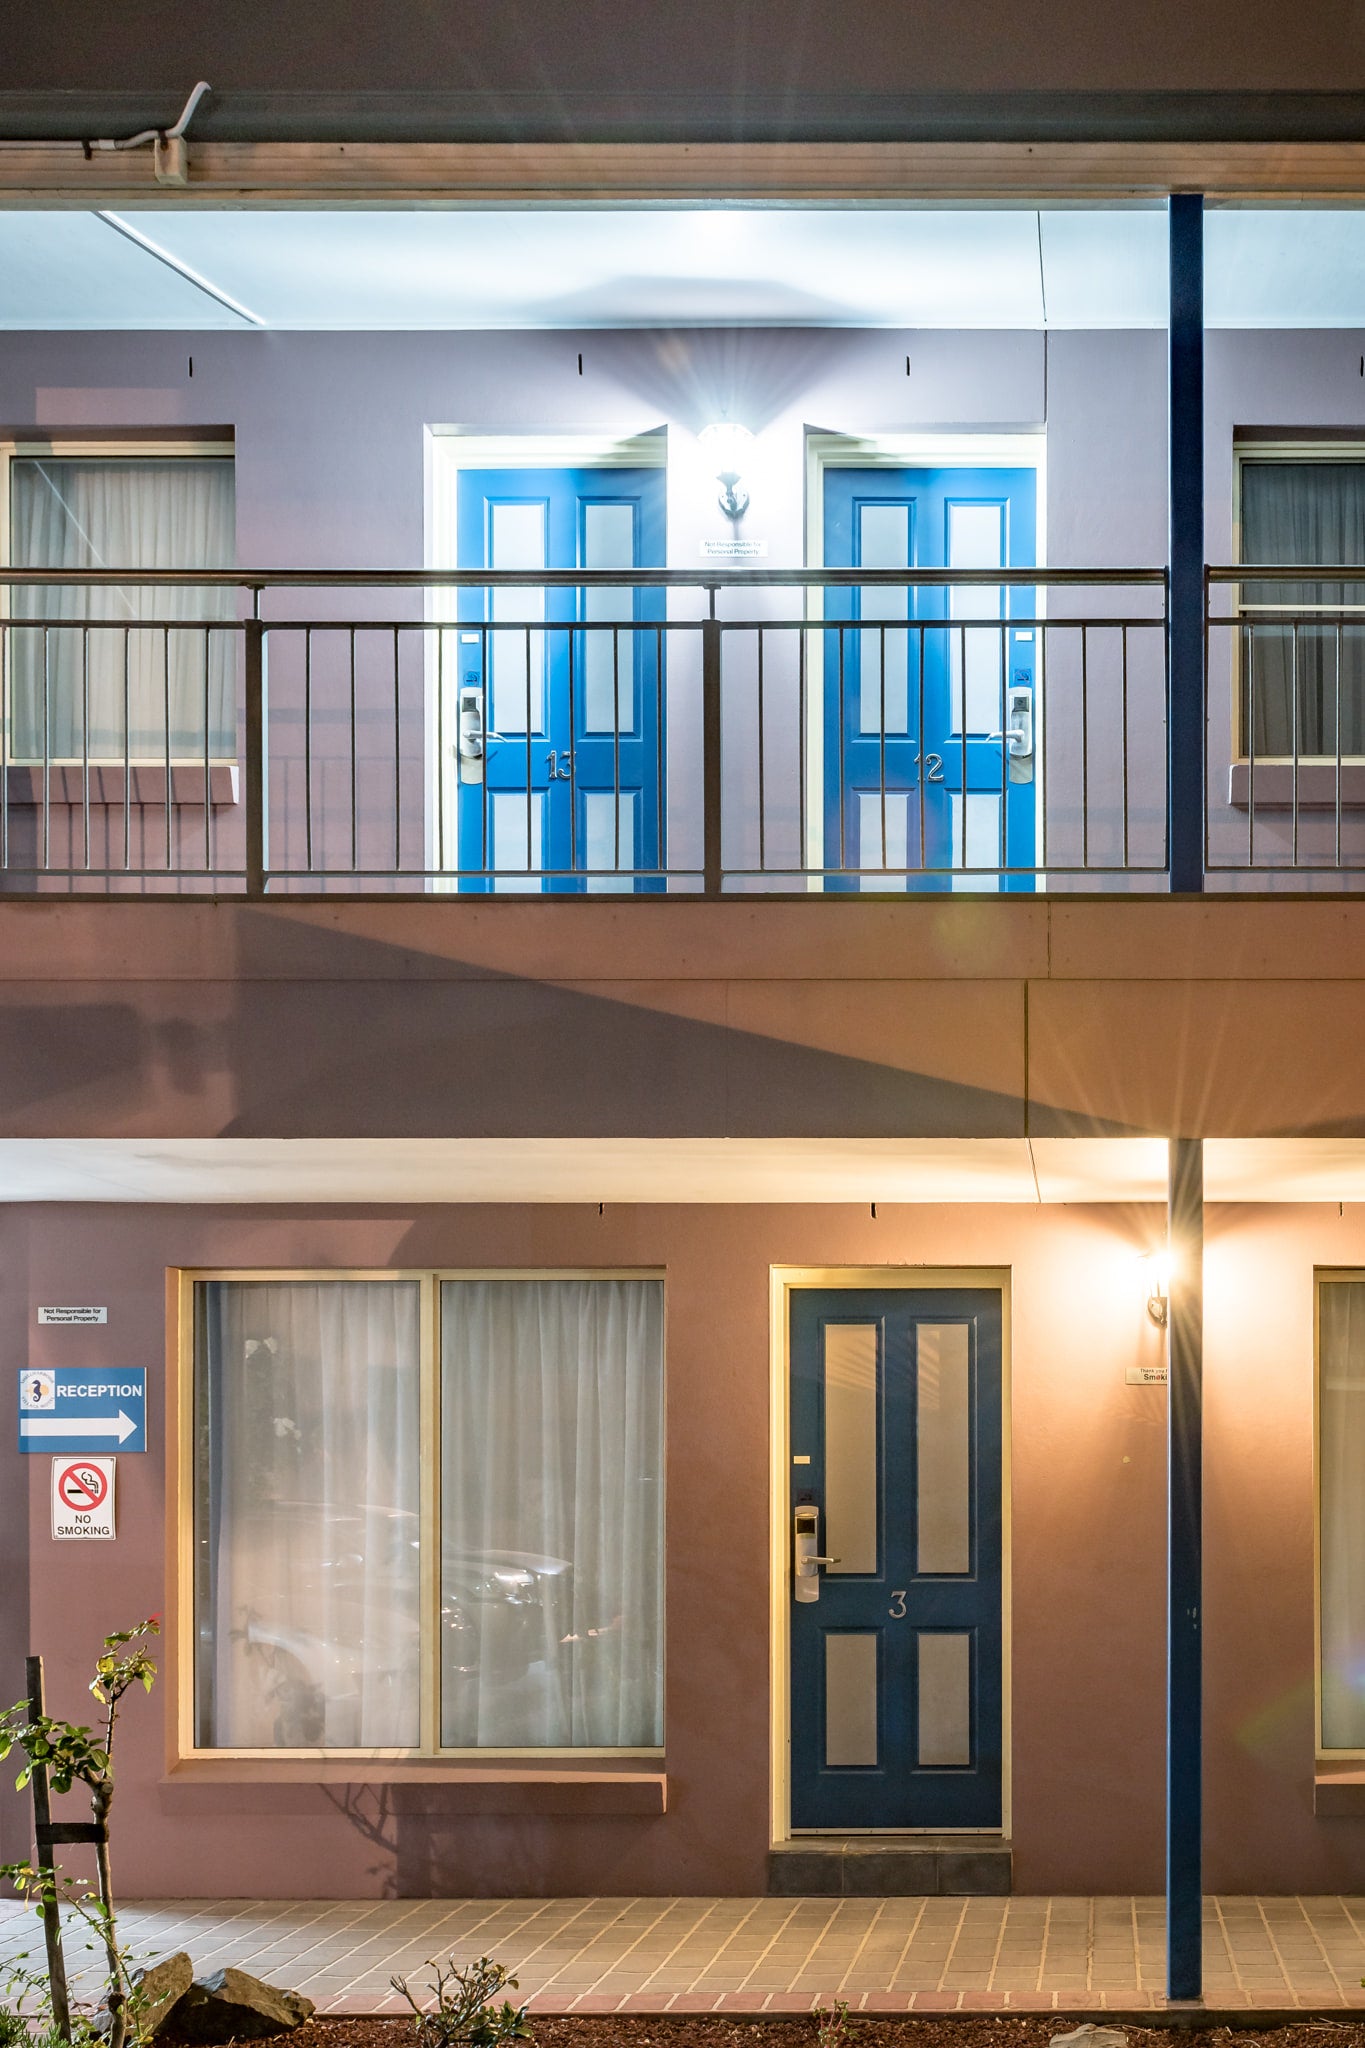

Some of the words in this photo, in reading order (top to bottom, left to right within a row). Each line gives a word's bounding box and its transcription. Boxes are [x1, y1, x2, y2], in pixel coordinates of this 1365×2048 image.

[717, 541, 752, 549] Responsible
[546, 750, 577, 779] 13
[1143, 1373, 1168, 1381] Smoki
[56, 1384, 142, 1397] RECEPTION
[75, 1514, 92, 1524] NO
[57, 1526, 110, 1535] SMOKING
[888, 1590, 907, 1619] 3
